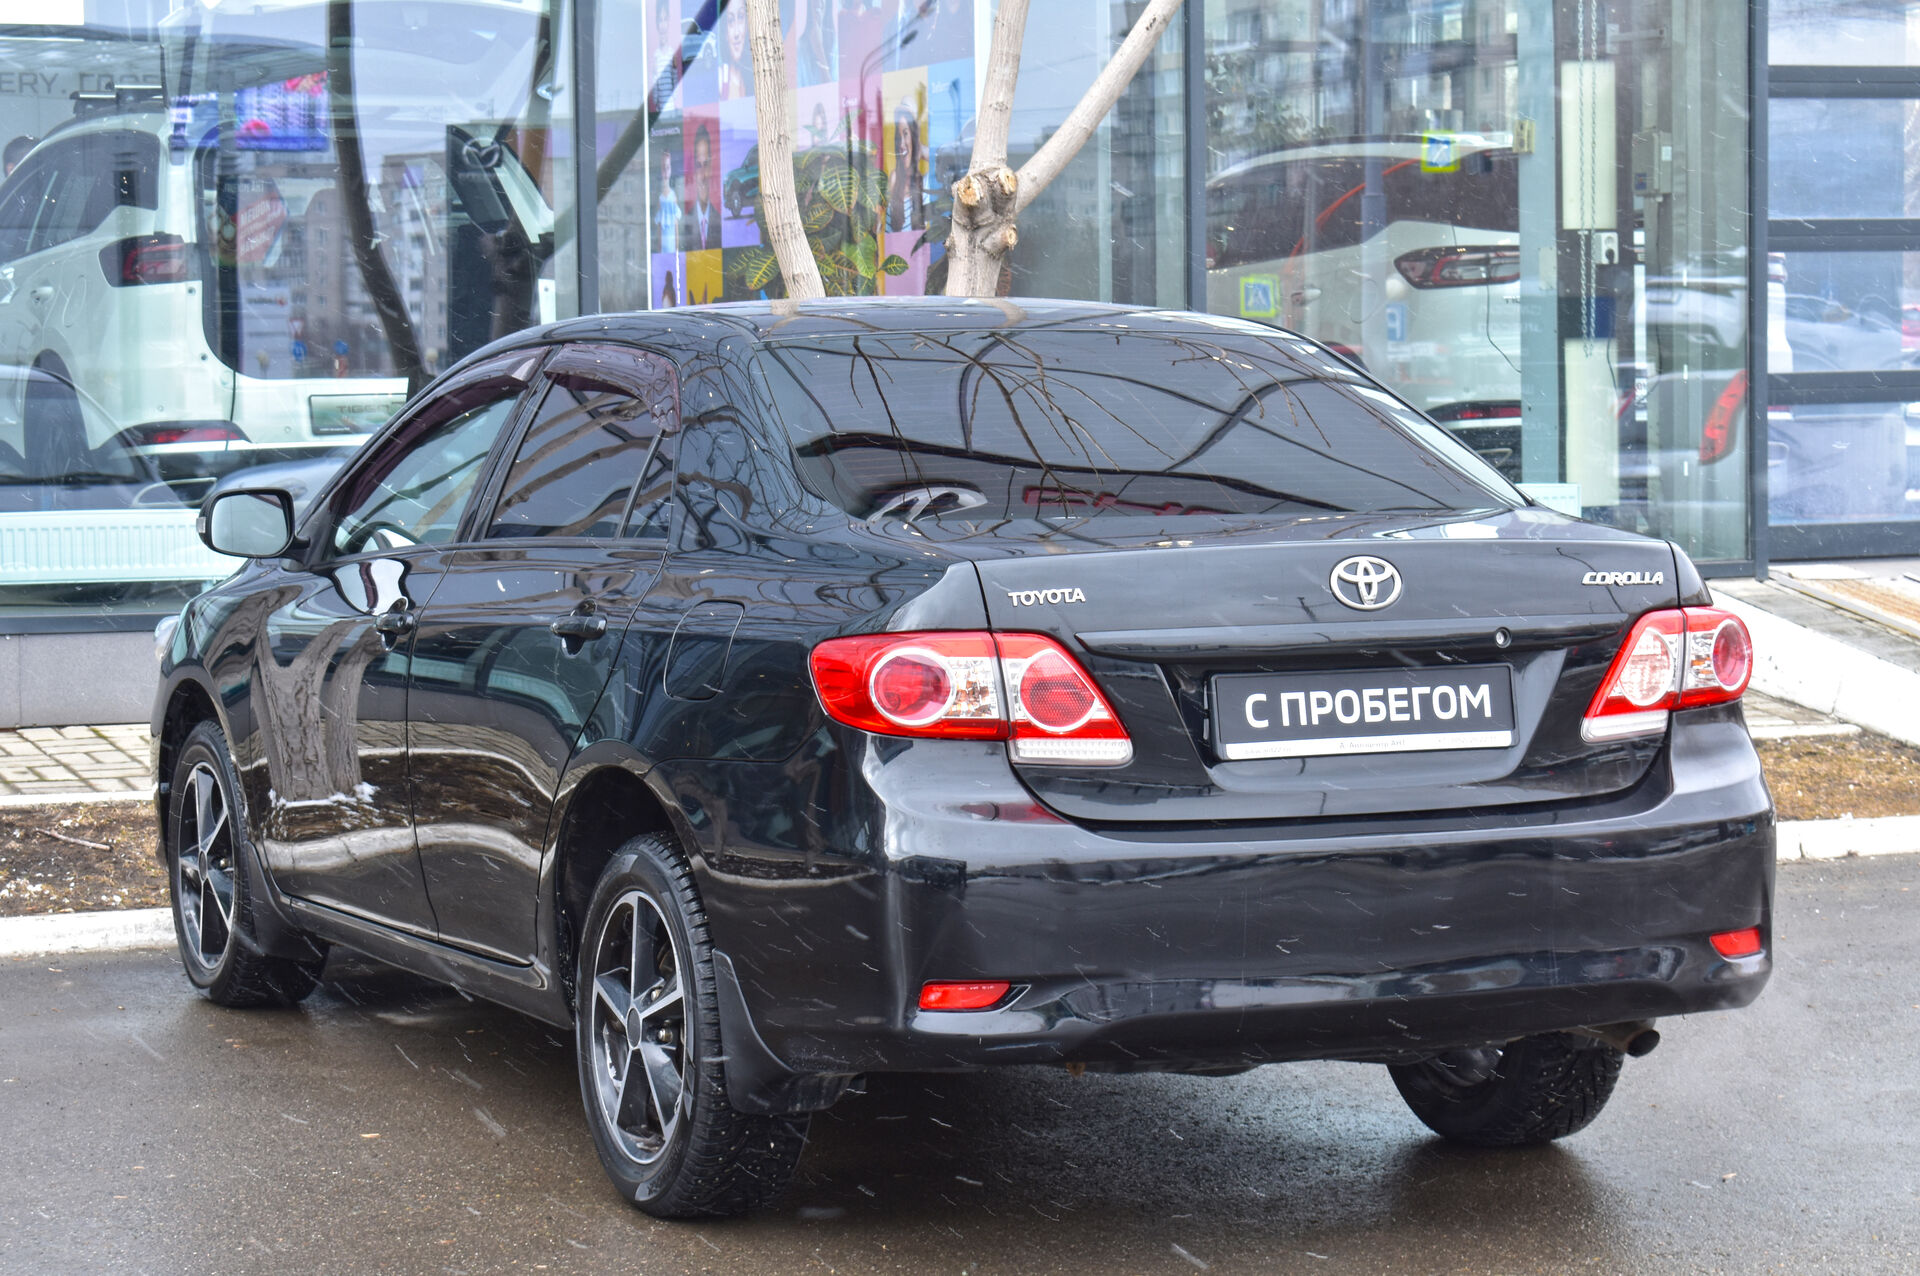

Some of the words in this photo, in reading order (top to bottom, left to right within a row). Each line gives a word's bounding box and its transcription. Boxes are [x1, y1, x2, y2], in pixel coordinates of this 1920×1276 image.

[1581, 570, 1664, 586] COROLLA
[1008, 587, 1086, 607] TOYOTA
[1245, 693, 1269, 728] С
[1280, 684, 1492, 727] ПРОБЕГОМ
